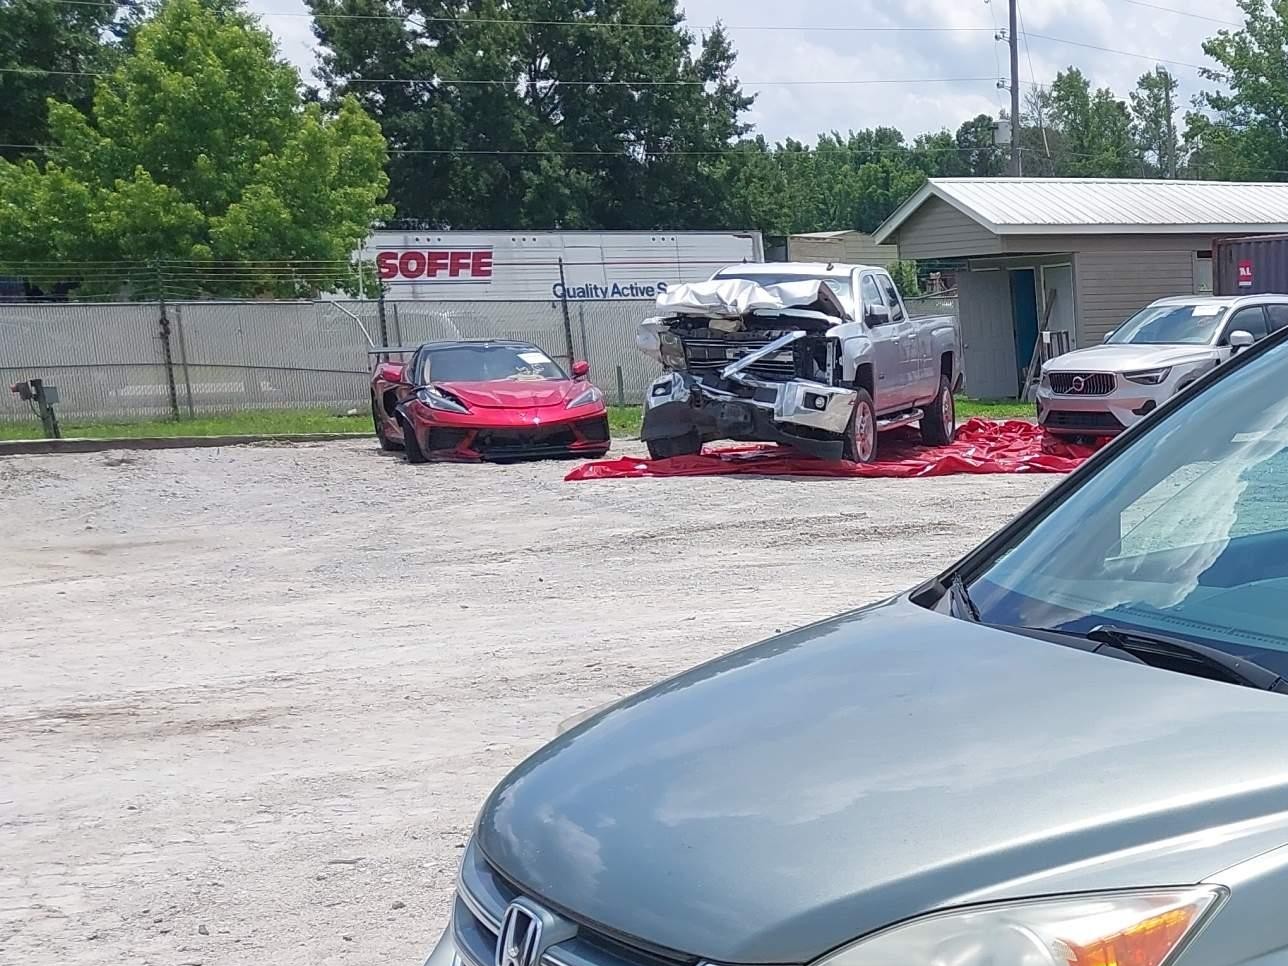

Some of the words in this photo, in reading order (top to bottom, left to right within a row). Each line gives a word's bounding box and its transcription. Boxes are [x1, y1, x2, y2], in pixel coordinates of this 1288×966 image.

[376, 251, 493, 279] SOFFE
[552, 282, 609, 299] Quality
[611, 282, 655, 298] Active
